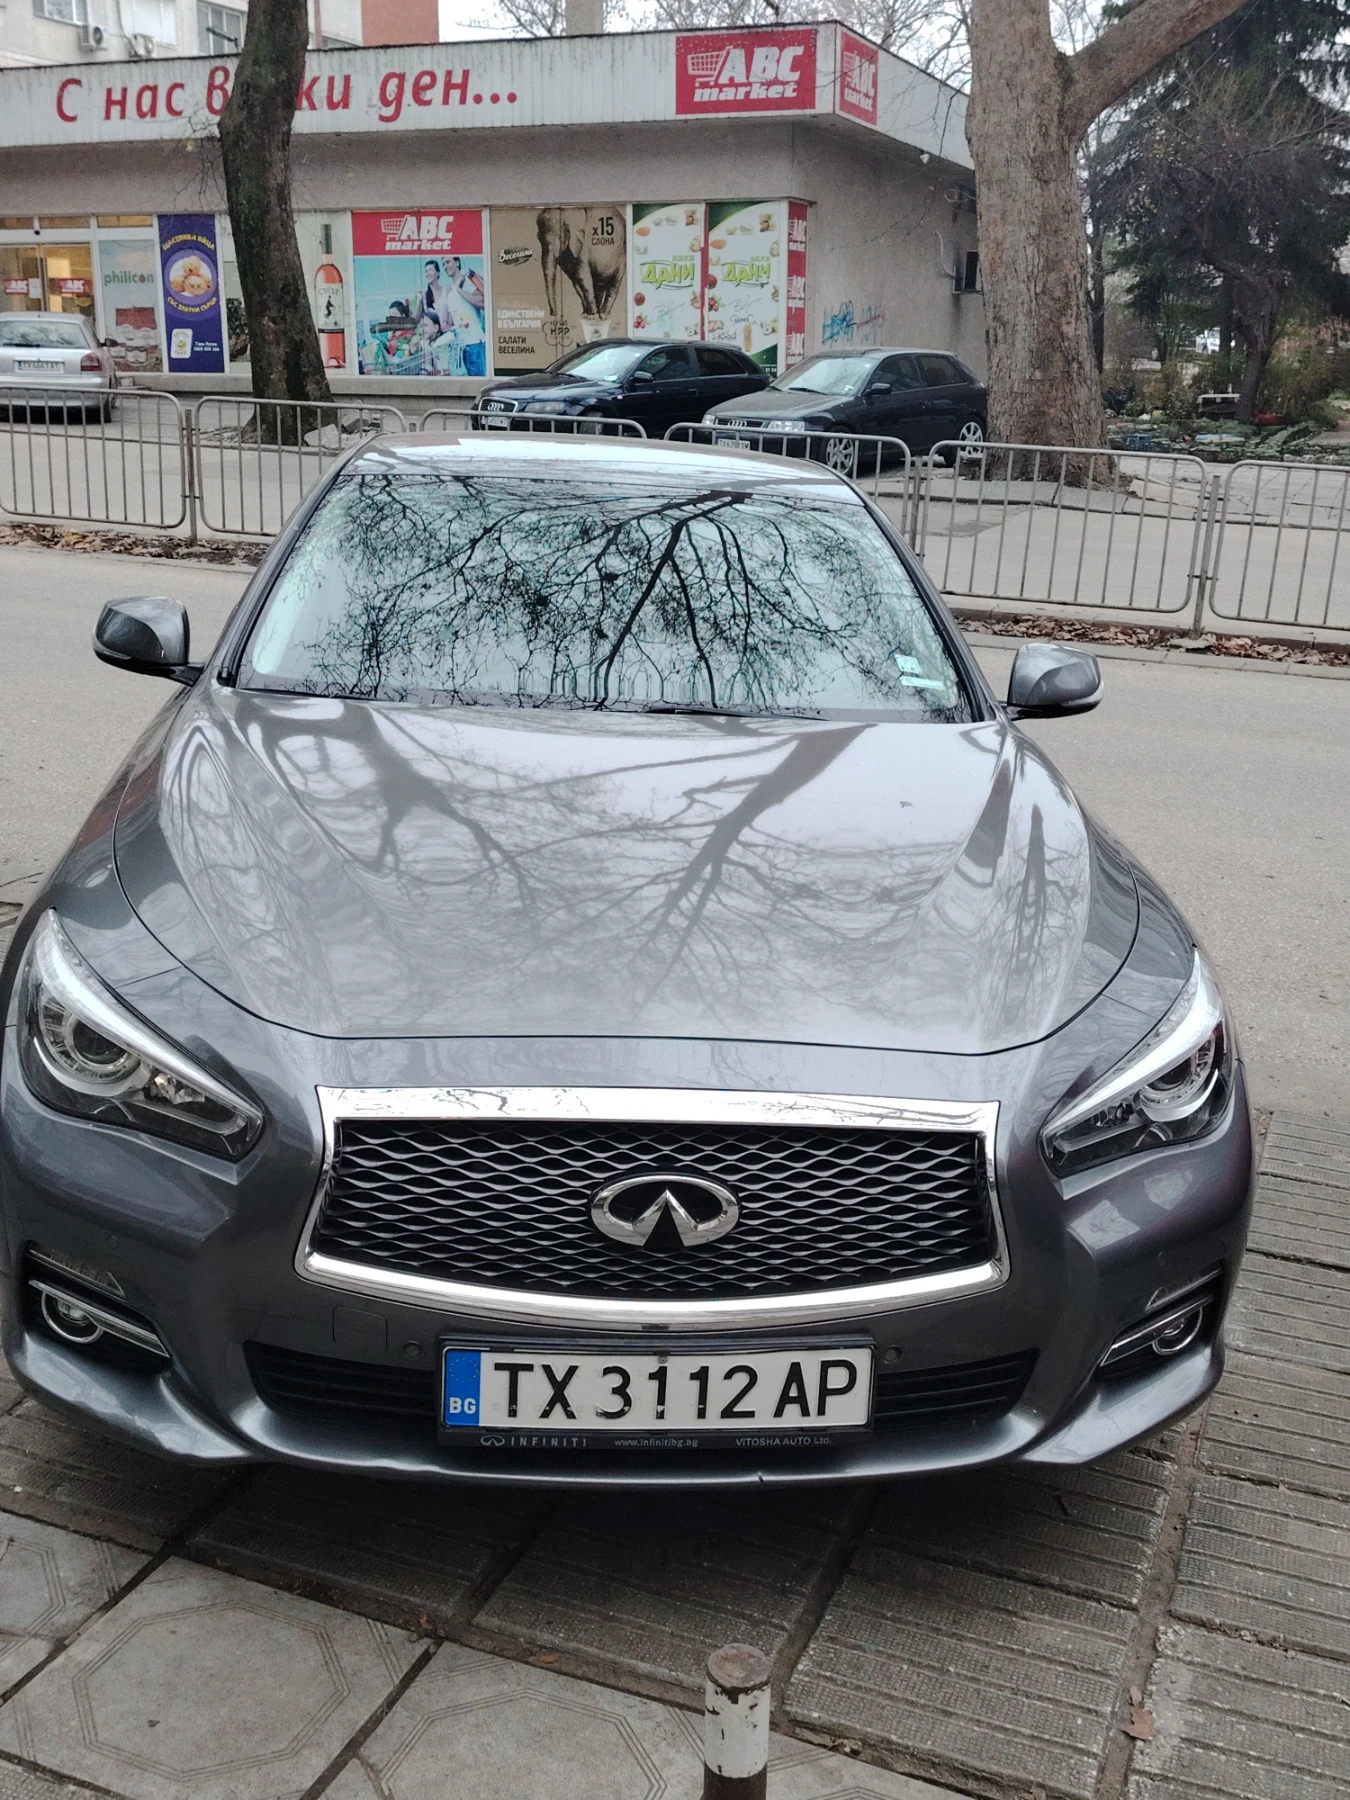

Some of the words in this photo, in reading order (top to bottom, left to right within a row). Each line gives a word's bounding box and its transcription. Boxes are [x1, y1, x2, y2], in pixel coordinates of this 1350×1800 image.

[718, 45, 804, 84] ABC
[852, 53, 876, 97] ABC
[56, 78, 82, 122] С
[104, 82, 185, 120] нас
[206, 65, 352, 116] вки
[693, 82, 799, 102] market
[844, 87, 873, 112] market
[400, 215, 454, 240] ABC
[385, 240, 451, 251] market
[591, 237, 615, 246] СЛОНА
[318, 287, 340, 295] CYCLE
[497, 309, 544, 319] ЕДИНСТВЕНИ
[503, 319, 541, 328] БЪЛГАРИЯ
[498, 336, 527, 344] САЛАТИ
[498, 346, 535, 354] ВЕСЕЛИНА
[449, 1397, 477, 1414] BG
[510, 1436, 587, 1447] INFINITI
[614, 1436, 698, 1448] www.infinitibg.bg
[736, 1437, 780, 1446] VITOSHA
[782, 1436, 811, 1446] AUTO
